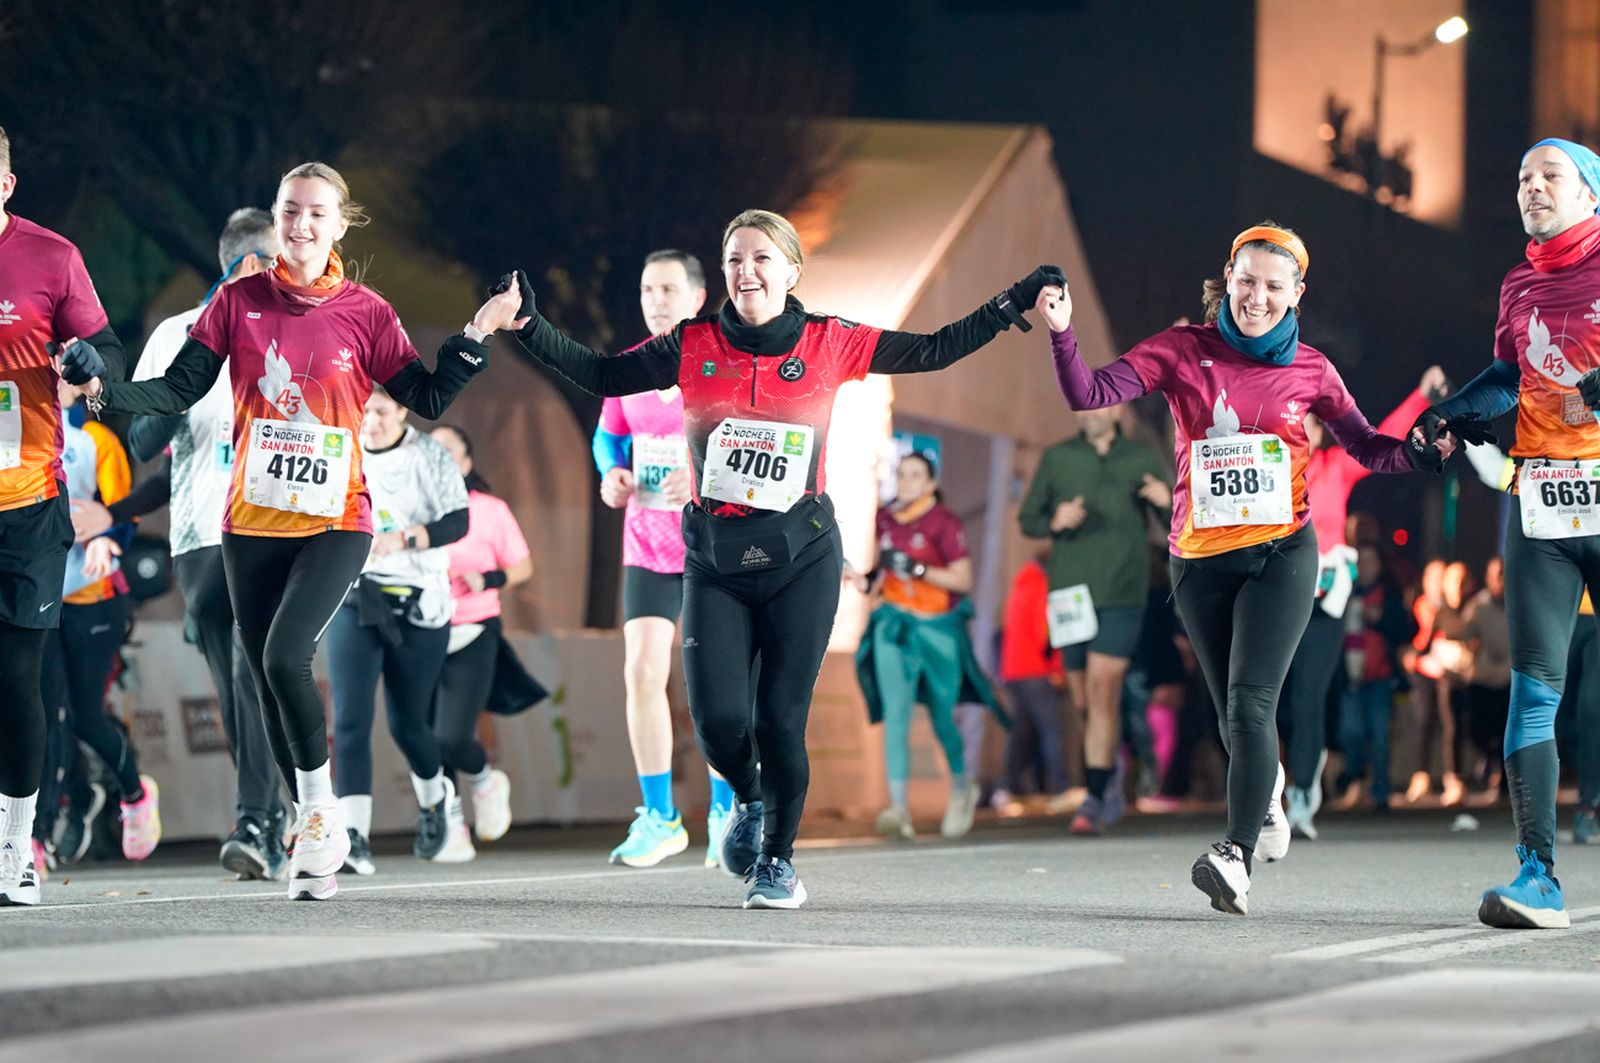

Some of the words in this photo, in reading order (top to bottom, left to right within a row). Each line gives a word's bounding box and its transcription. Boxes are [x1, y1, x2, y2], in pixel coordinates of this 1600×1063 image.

[1542, 353, 1565, 377] 43
[276, 389, 301, 415] 43
[273, 432, 302, 442] NOCHE
[304, 434, 316, 443] DE
[733, 430, 763, 440] NOCHE
[764, 432, 776, 441] DE
[261, 440, 280, 451] SAN
[720, 438, 739, 449] SAN
[1213, 446, 1240, 457] NOCHE
[1242, 445, 1253, 454] DE
[267, 453, 328, 485] 4126
[726, 448, 788, 481] 4706
[1203, 459, 1222, 471] SAN
[1530, 470, 1549, 480] SAN
